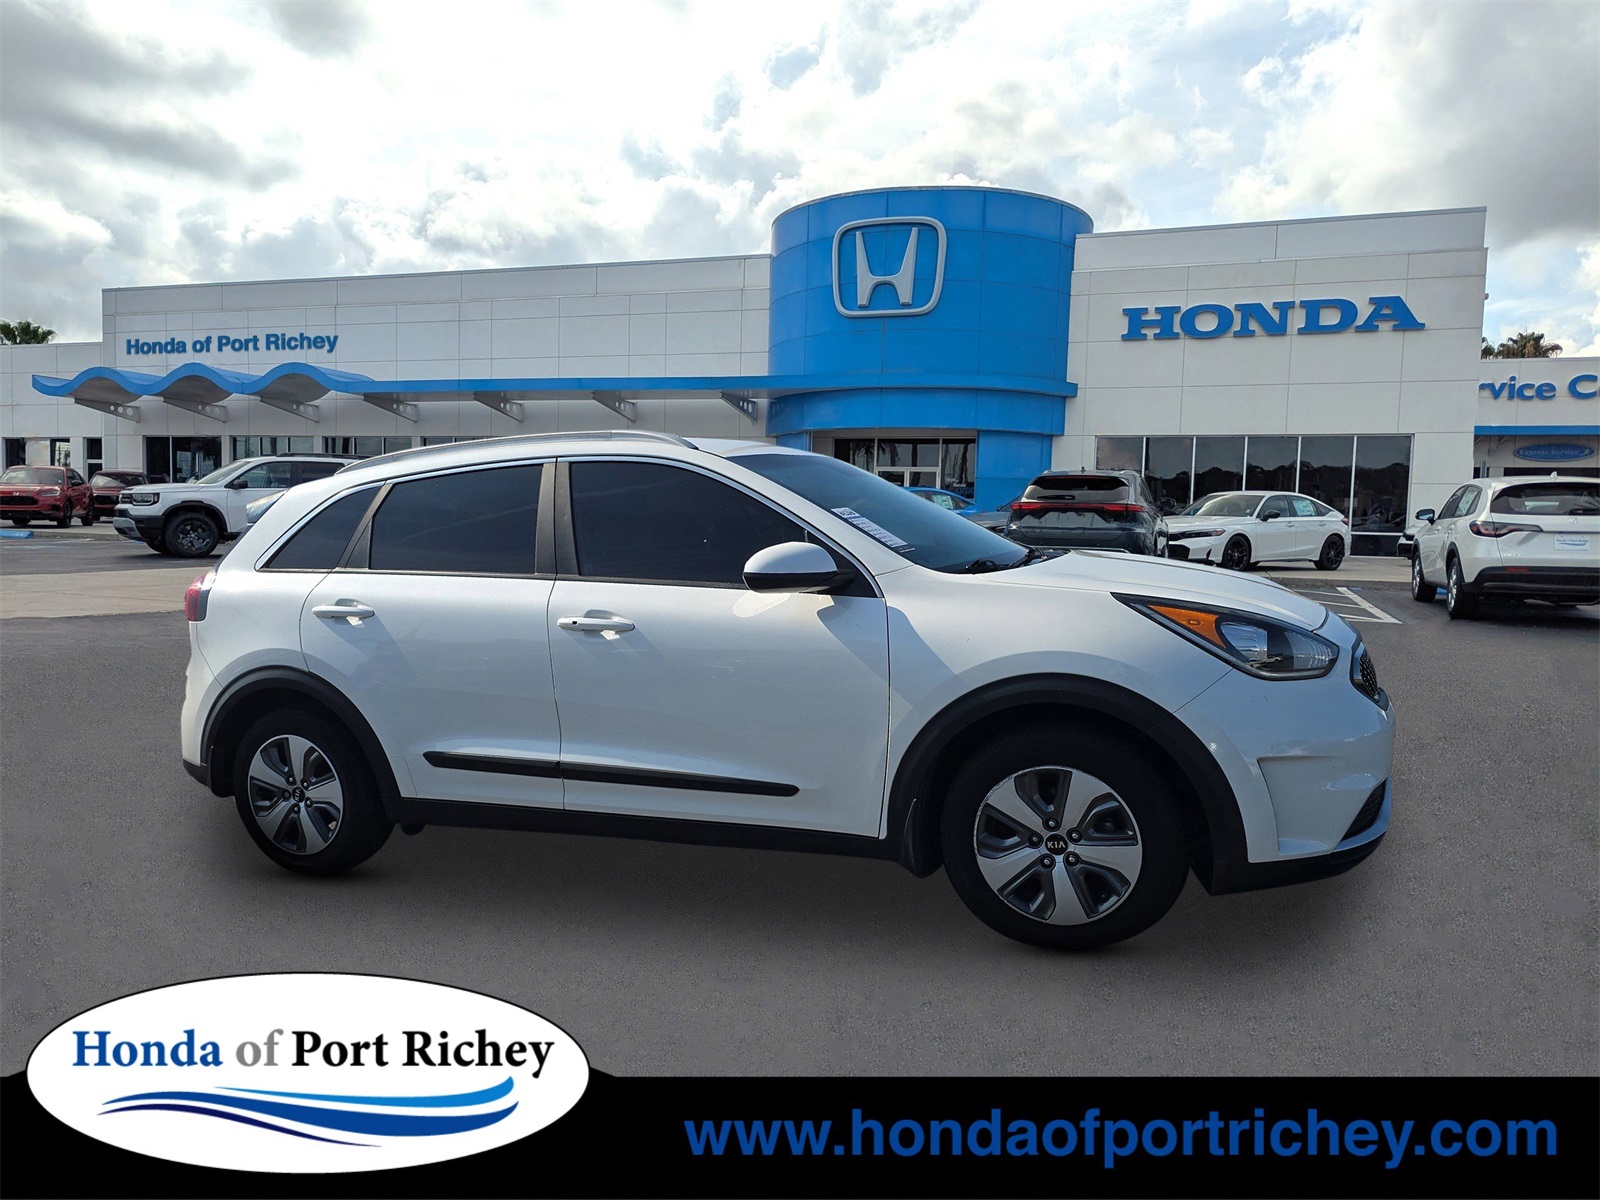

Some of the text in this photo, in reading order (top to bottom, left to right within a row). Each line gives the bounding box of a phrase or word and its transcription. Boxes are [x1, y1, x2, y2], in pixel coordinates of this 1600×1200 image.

[1121, 295, 1426, 341] HONDA
[126, 332, 339, 355] Honda of Port Richey
[1046, 841, 1066, 849] KIA
